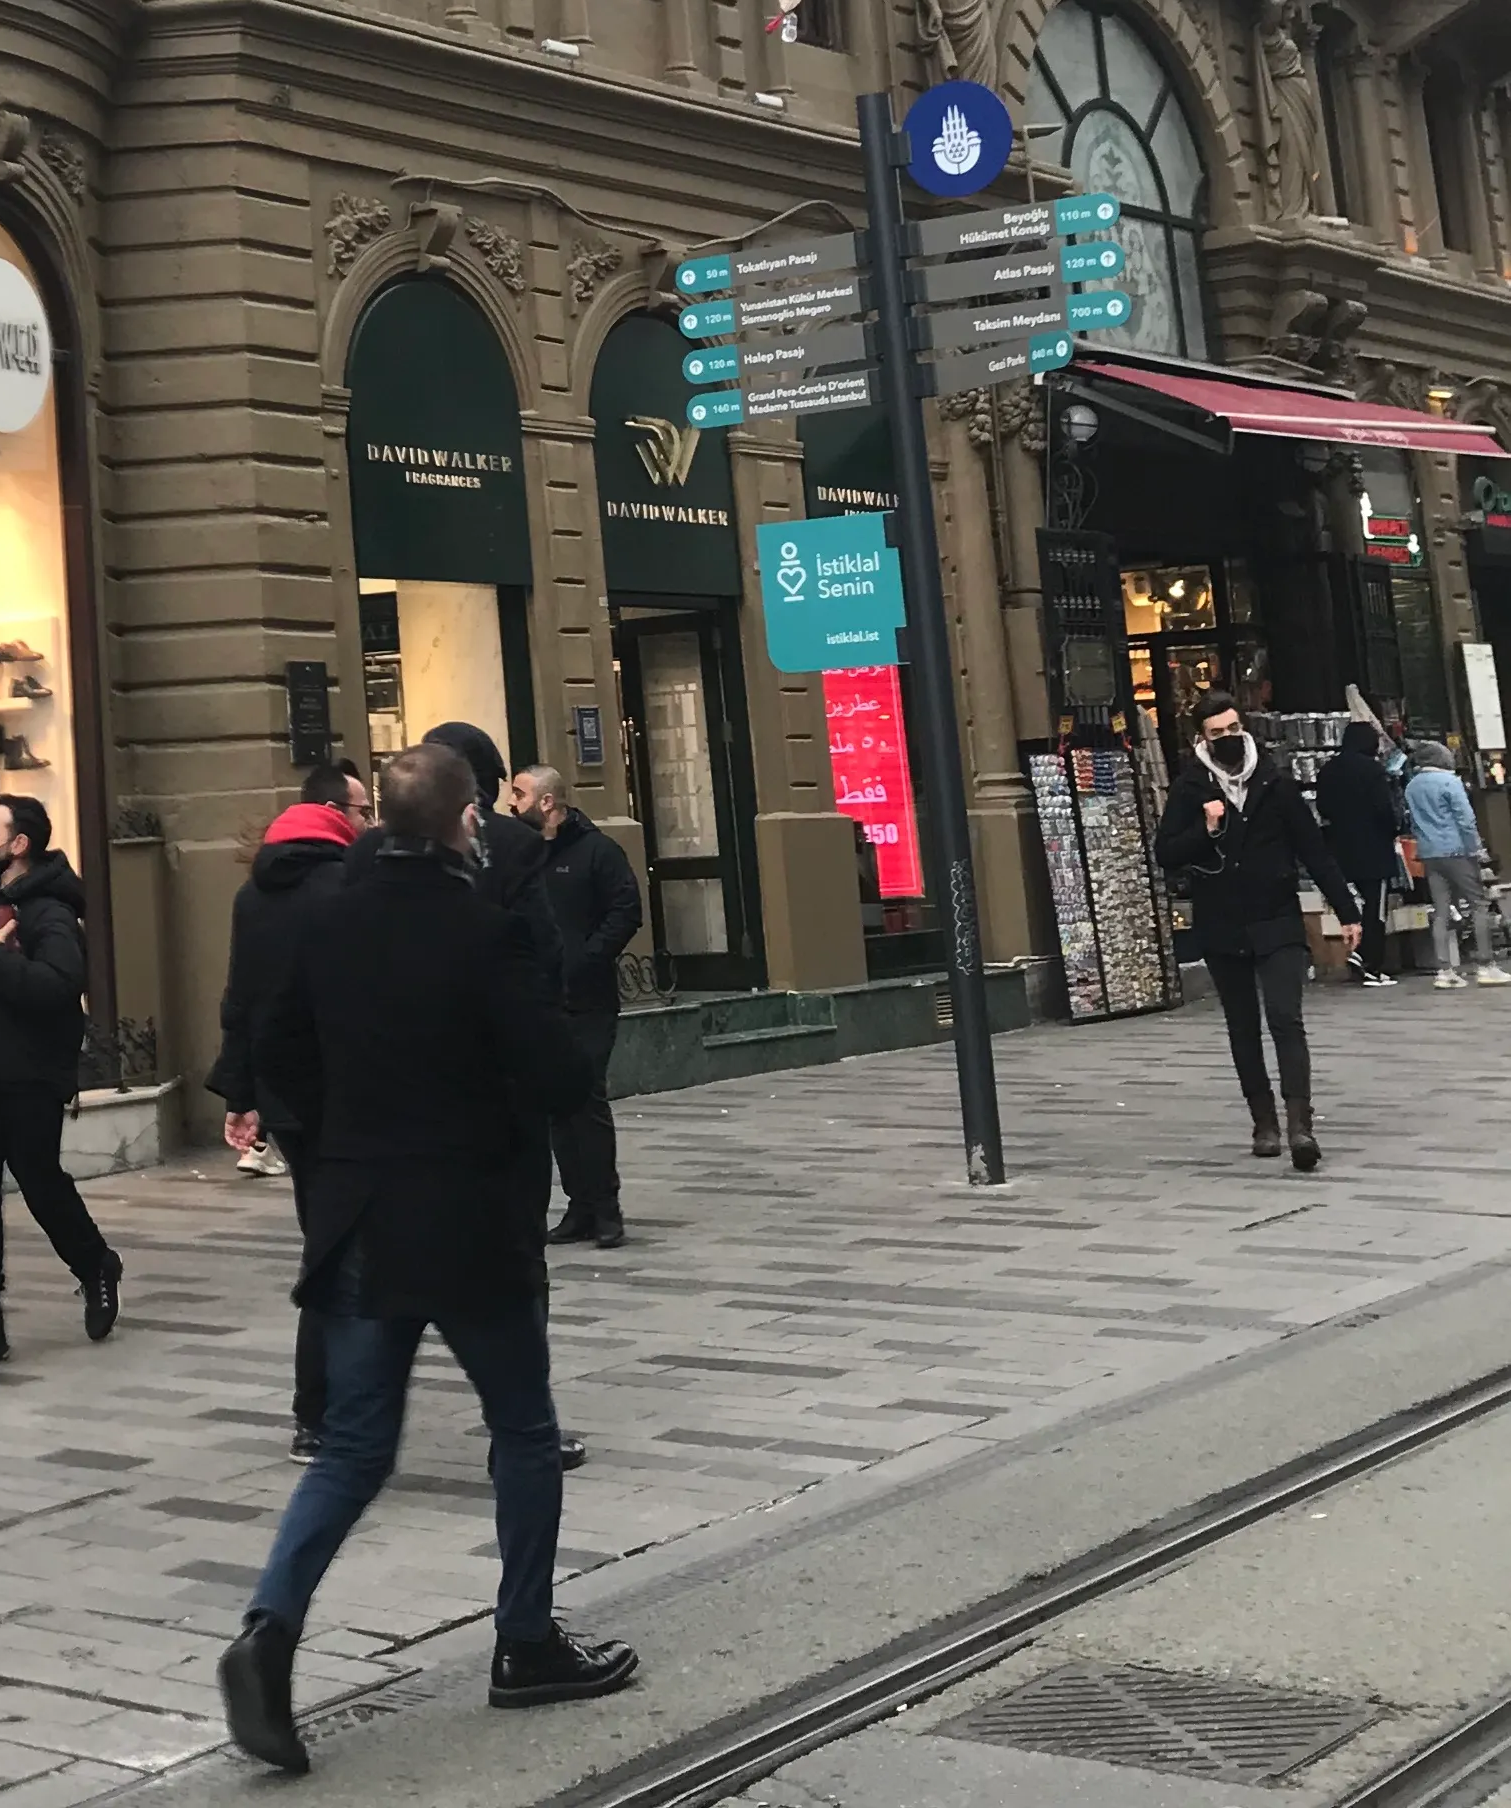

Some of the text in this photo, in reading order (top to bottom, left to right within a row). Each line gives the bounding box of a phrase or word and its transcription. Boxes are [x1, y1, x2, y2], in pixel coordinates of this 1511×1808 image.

[1003, 208, 1049, 226] Beyoğlu
[960, 221, 1050, 245] Hükümet Konağı
[736, 252, 817, 275] Tokatlıyan Pasajı
[994, 261, 1055, 281] Atlas Pasajı
[1065, 258, 1096, 269] 120 m
[706, 269, 728, 279] 50 m
[740, 297, 787, 312] Yunanistan
[817, 285, 853, 300] Merkezi
[705, 313, 732, 324] 120 m
[796, 304, 831, 319] Megaro
[1071, 307, 1102, 318] 700 m
[973, 312, 1061, 332] Taksim Meydanı
[708, 359, 735, 370] 120 m
[743, 346, 805, 365] Halep Pasajı
[989, 359, 1007, 372] Gezi
[747, 390, 776, 403] Grand
[749, 401, 788, 415] Madame
[789, 396, 830, 410] Tussauds
[713, 403, 740, 414] 160 m
[405, 470, 482, 489] FRAGRANCES
[816, 551, 880, 576] İstiklal
[817, 576, 874, 599] Senin
[835, 775, 887, 804] فقط
